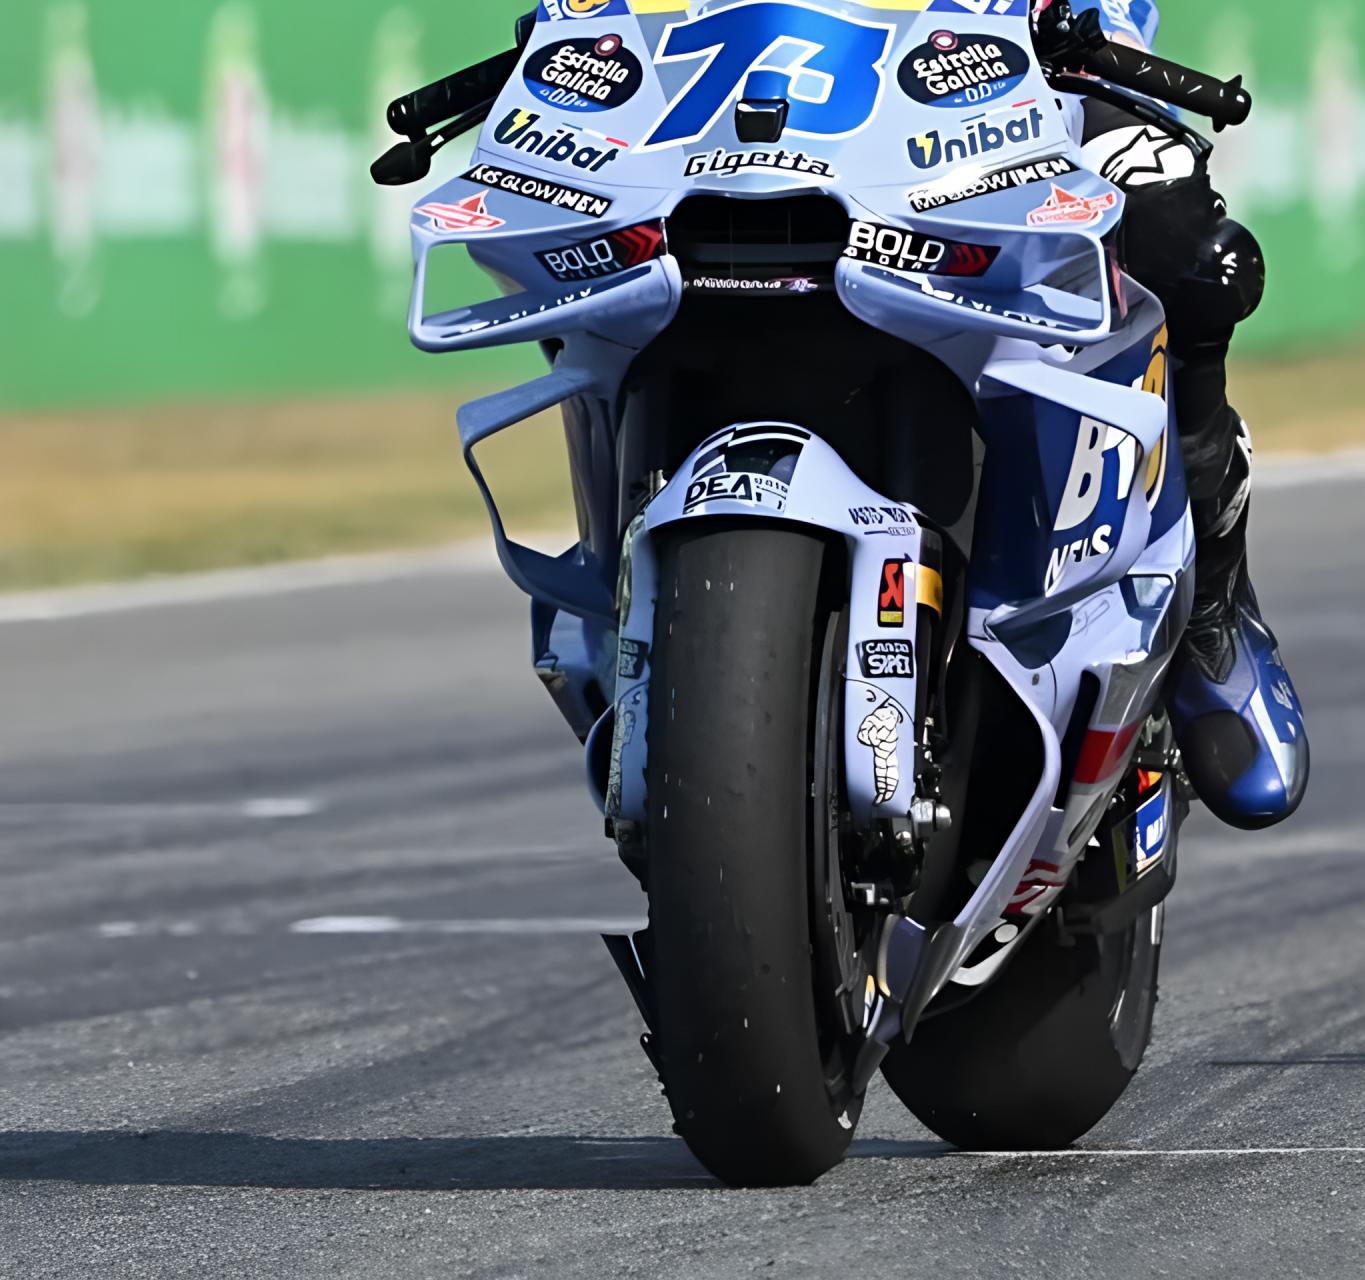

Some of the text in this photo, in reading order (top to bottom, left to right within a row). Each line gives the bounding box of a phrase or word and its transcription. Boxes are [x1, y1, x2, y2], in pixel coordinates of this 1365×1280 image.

[494, 108, 619, 173] Unibat
[907, 106, 1043, 169] Unibat
[684, 148, 836, 178] Gigetta
[544, 238, 613, 273] BOLD
[849, 220, 945, 264] BOLD
